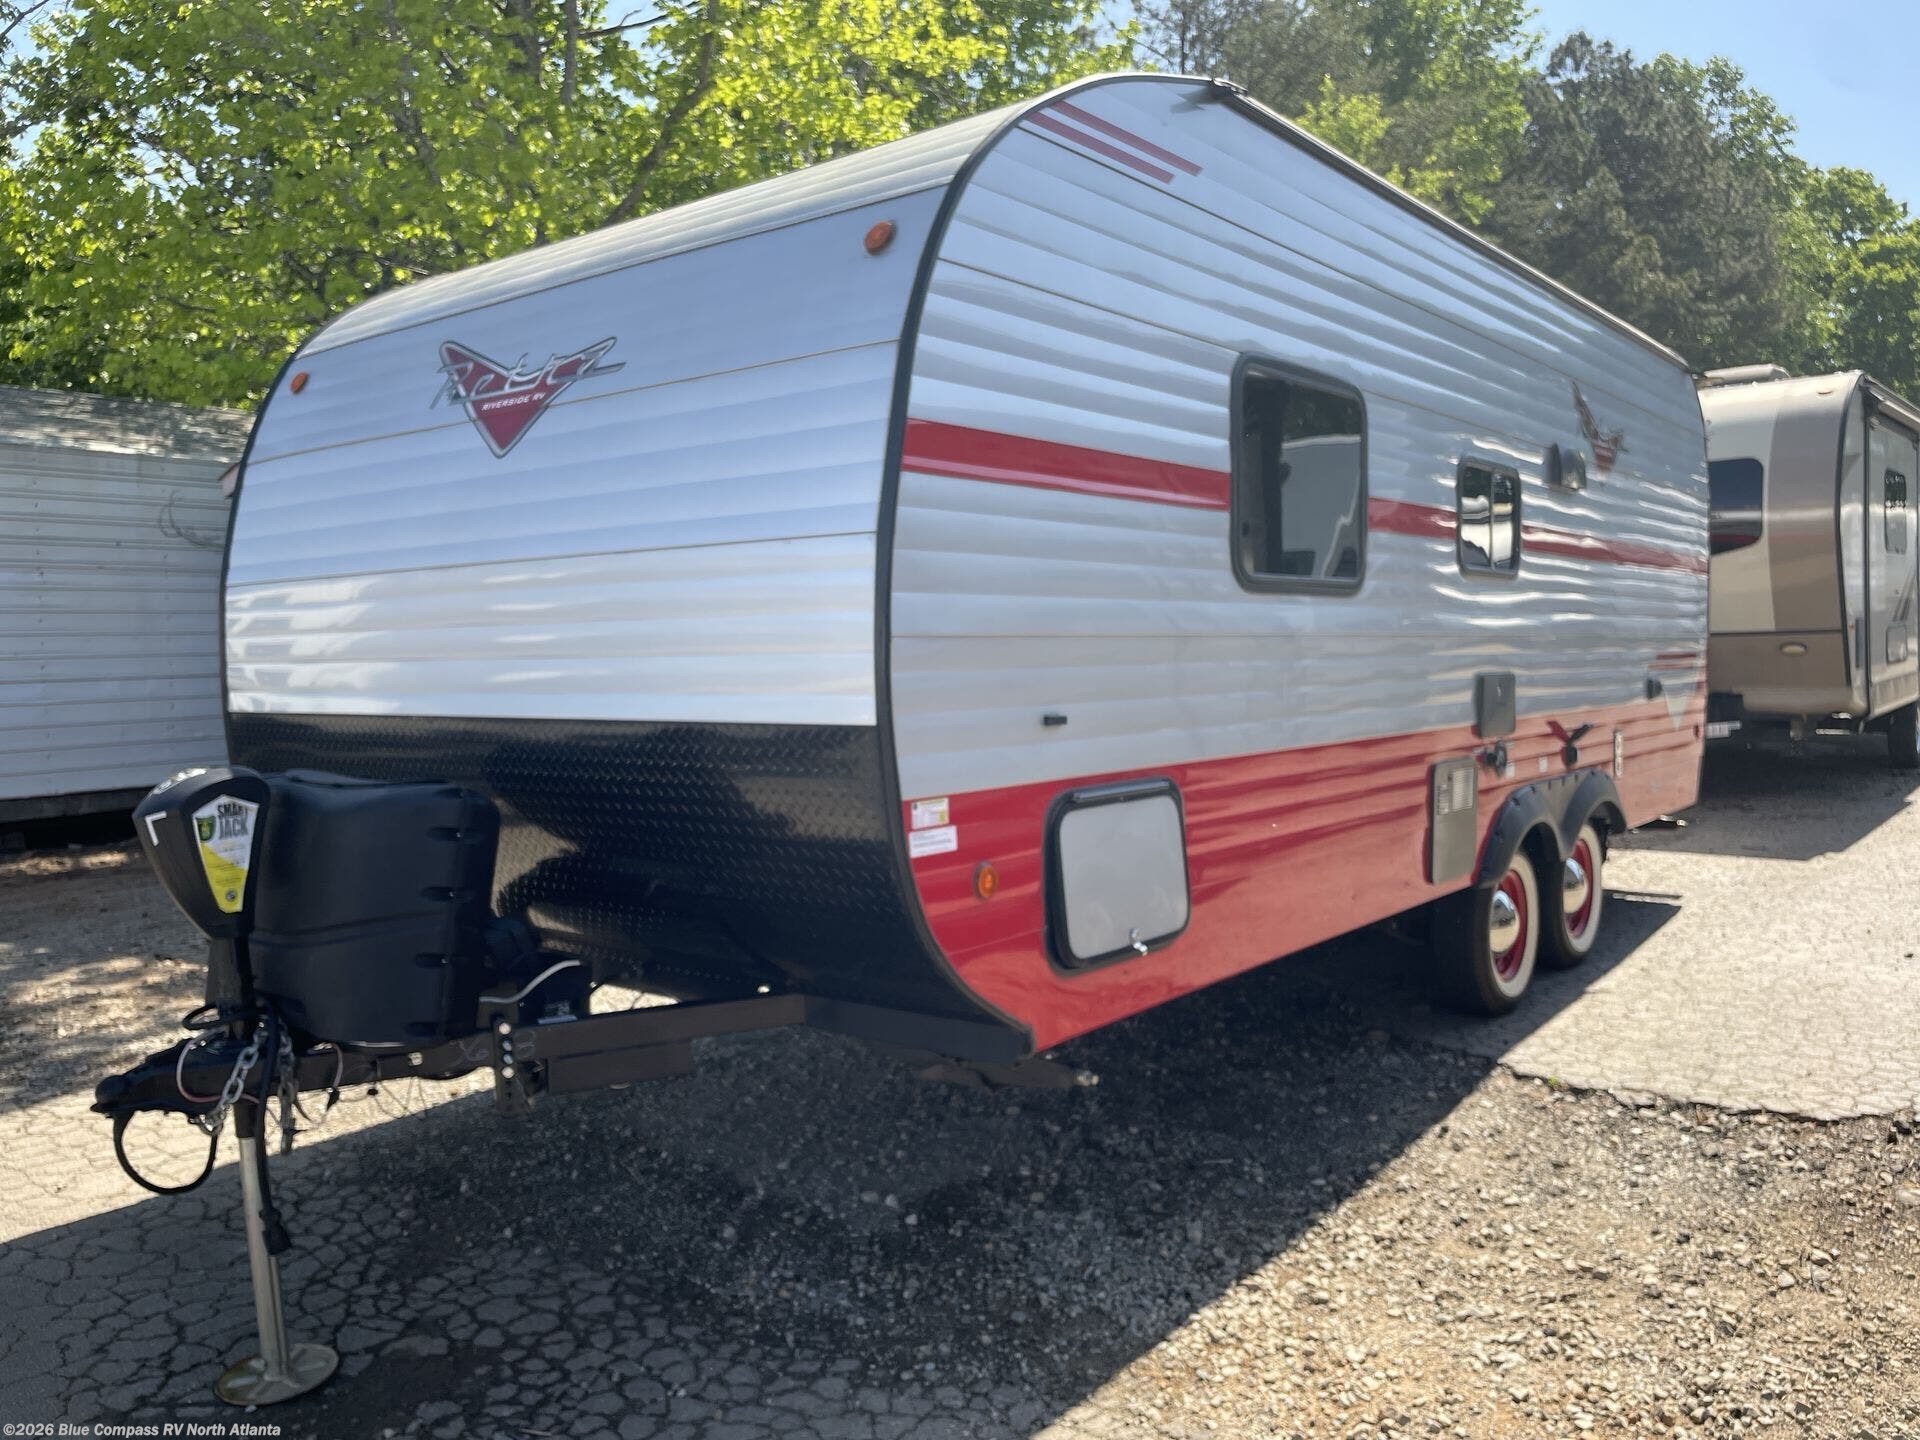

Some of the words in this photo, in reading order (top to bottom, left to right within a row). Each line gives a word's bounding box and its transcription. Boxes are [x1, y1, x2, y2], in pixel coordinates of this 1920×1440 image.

[481, 394, 531, 411] RIVERSIDE
[532, 392, 546, 401] RV
[217, 802, 249, 818] SMART
[218, 815, 249, 840] JACK
